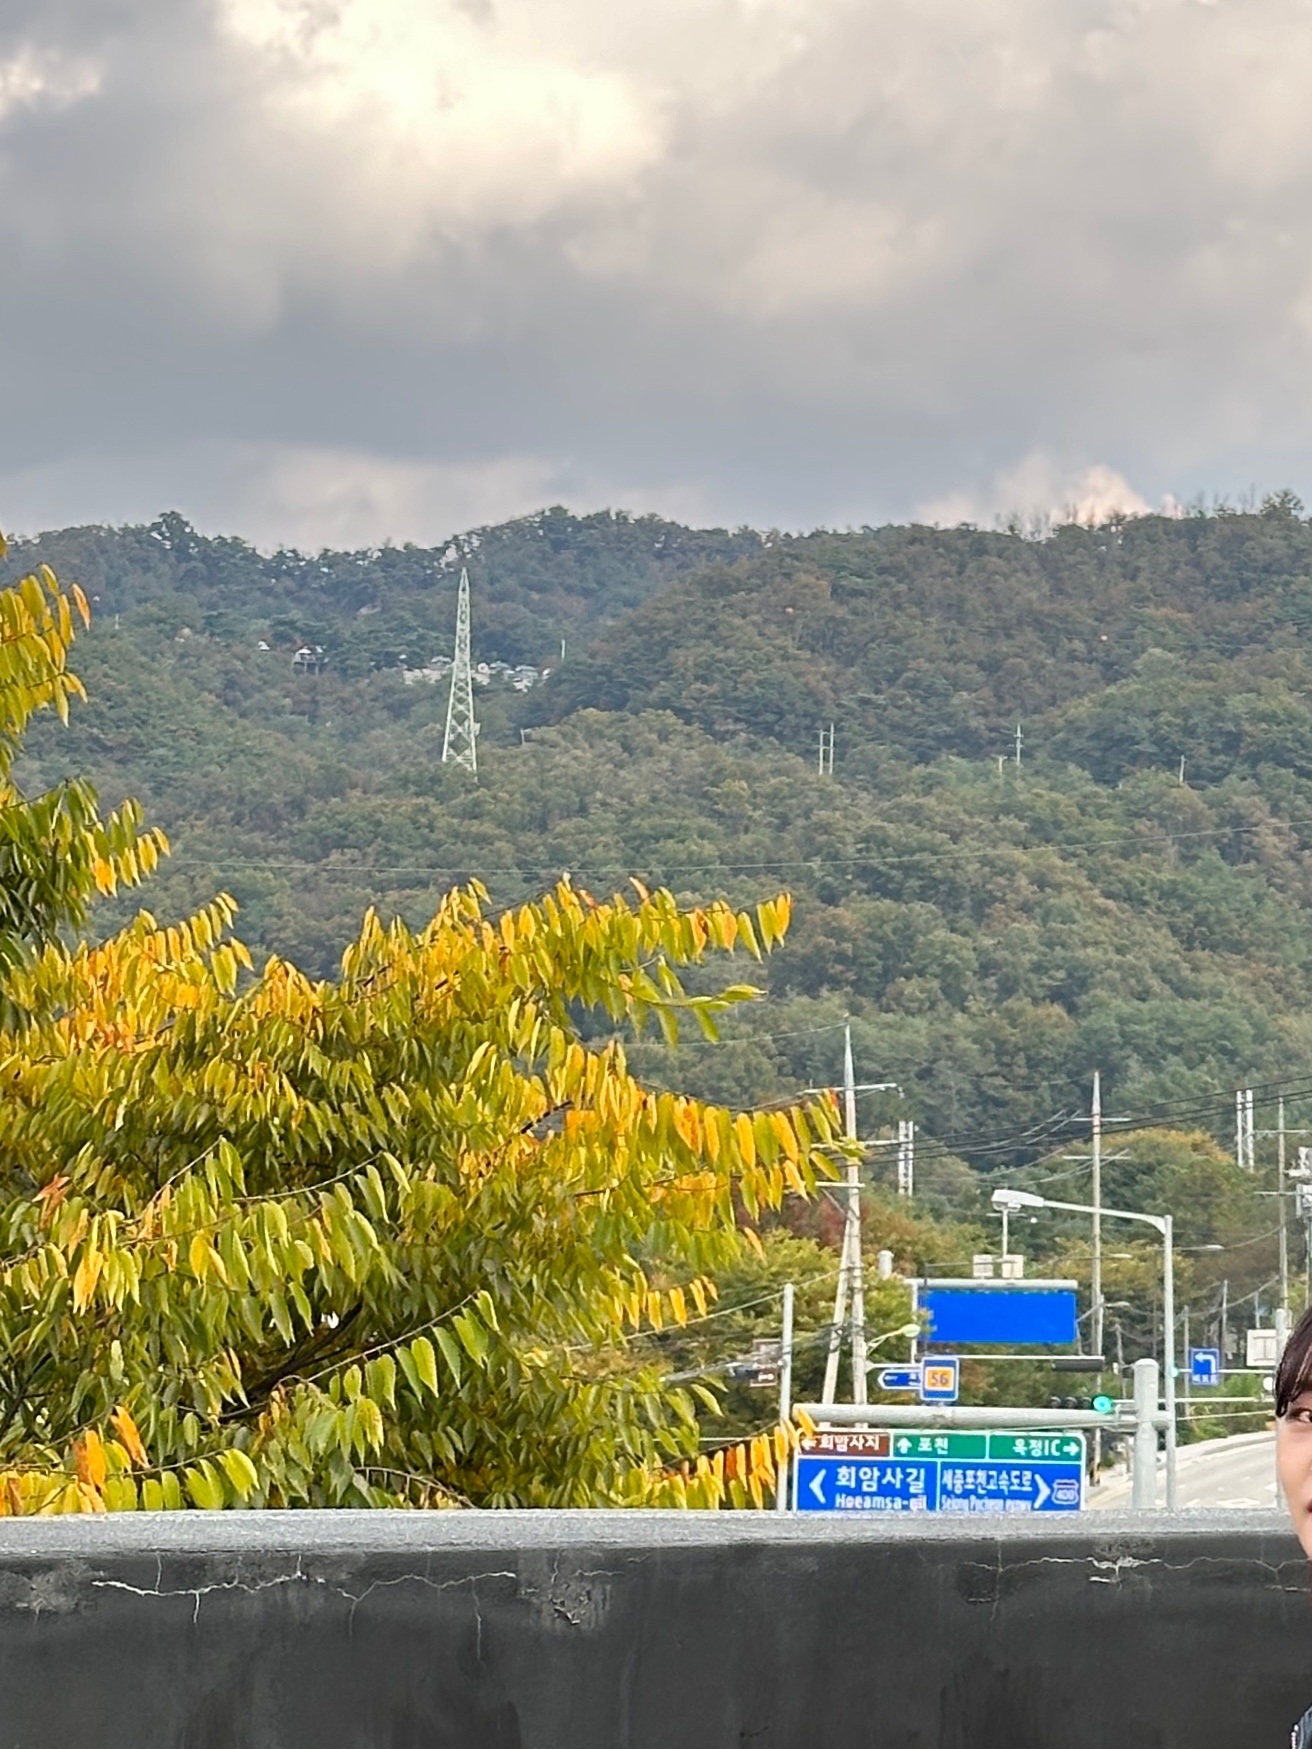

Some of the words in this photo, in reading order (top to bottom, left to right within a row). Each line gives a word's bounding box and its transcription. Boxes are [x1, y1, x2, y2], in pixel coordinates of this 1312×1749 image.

[931, 1371, 949, 1386] 56
[917, 1437, 949, 1455] 포천
[1012, 1438, 1061, 1457] 옥정IC
[835, 1465, 926, 1494] 회암사길
[941, 1468, 1033, 1495] 세종포천고속도로
